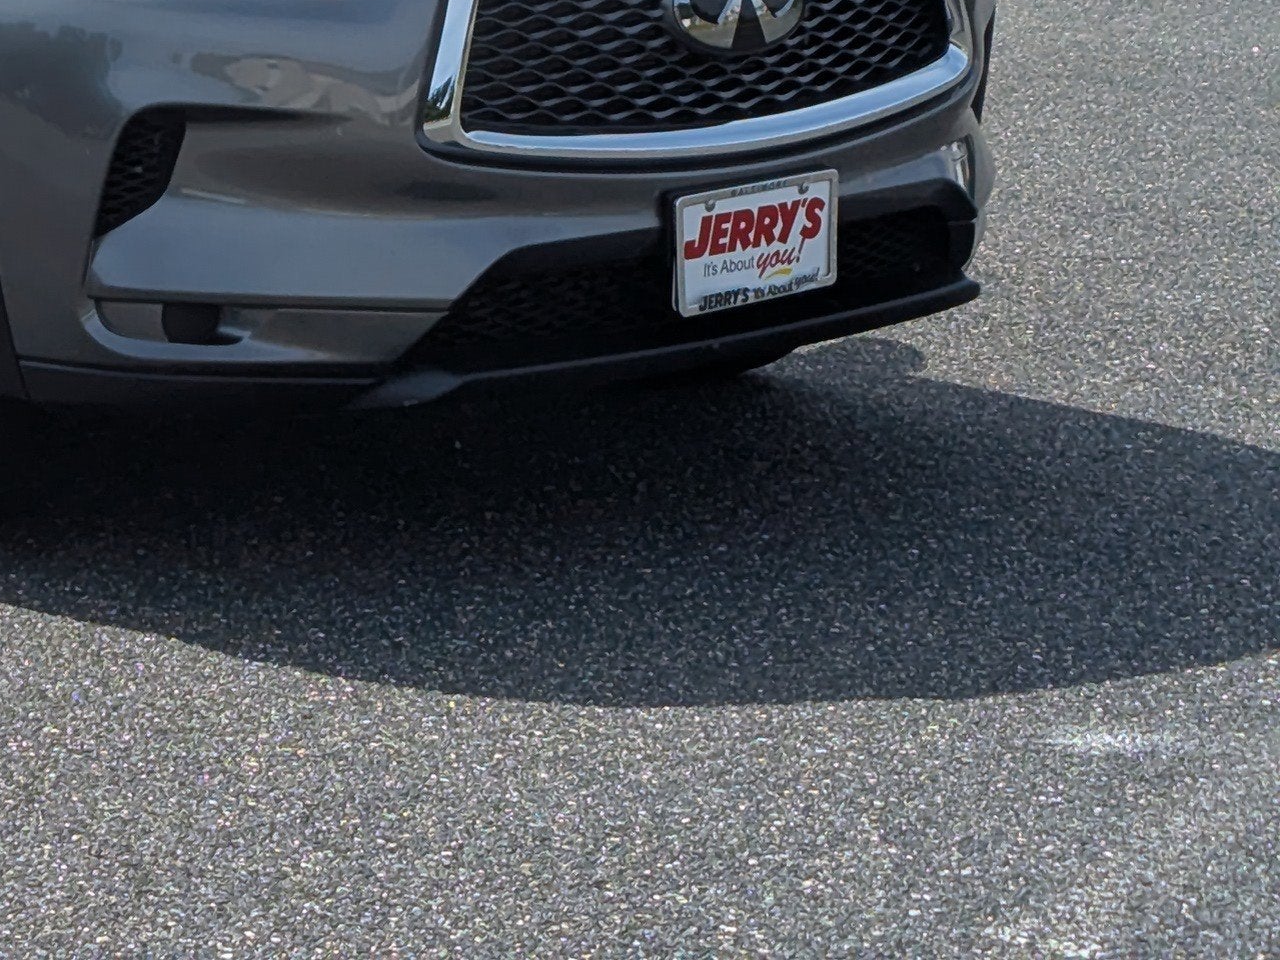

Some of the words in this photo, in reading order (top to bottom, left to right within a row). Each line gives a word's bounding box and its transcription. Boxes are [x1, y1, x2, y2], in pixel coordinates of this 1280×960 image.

[683, 196, 826, 261] JERRY'S
[703, 261, 719, 278] It's
[720, 255, 755, 275] About
[756, 237, 806, 279] you!
[698, 286, 751, 312] JERRY'S
